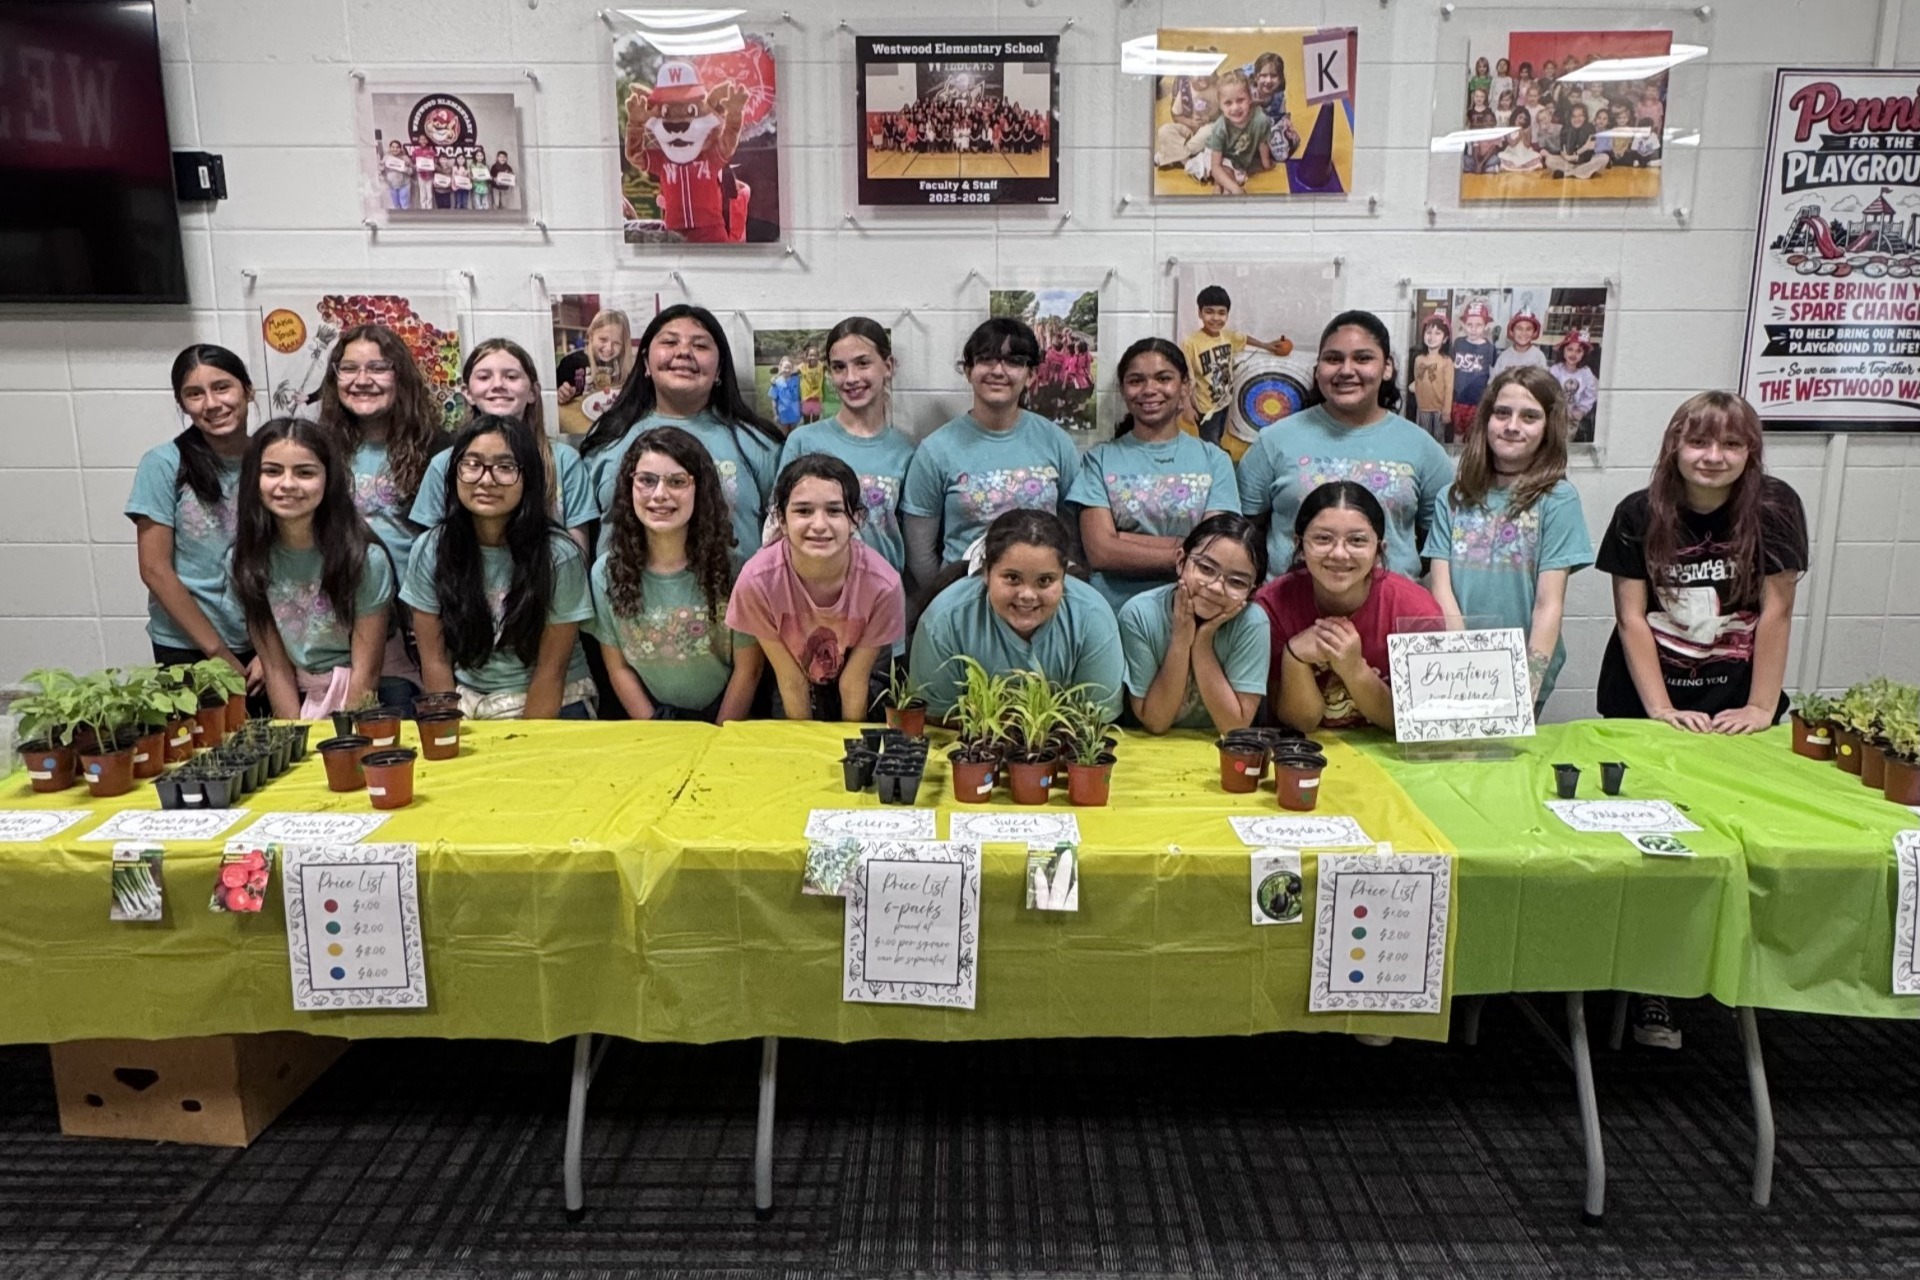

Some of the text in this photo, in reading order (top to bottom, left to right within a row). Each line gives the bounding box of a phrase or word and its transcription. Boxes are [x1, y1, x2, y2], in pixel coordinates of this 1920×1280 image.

[872, 42, 1044, 56] Westwood Elementary School
[667, 68, 683, 83] W
[1317, 50, 1338, 92] K
[1849, 136, 1915, 149] FOR THE
[1785, 152, 1920, 189] PLAYGROU
[918, 180, 998, 192] Faculty & Staff
[928, 193, 991, 203] 2025-2026
[1769, 281, 1830, 301] PLEASE
[1833, 282, 1886, 300] BRING
[1889, 283, 1908, 300] IN
[1789, 302, 1847, 321] SPARE
[1788, 328, 1804, 339] TO
[1806, 328, 1835, 339] HELP
[1837, 328, 1870, 339] BRING
[1872, 328, 1895, 339] OUR
[1788, 342, 1920, 353] PLAYGROUND TO LIFE!
[1787, 362, 1802, 376] So
[1804, 366, 1817, 374] we
[1840, 362, 1867, 375] work
[1759, 380, 1791, 402] THE
[1795, 377, 1894, 400] WESTWOOD
[1420, 661, 1499, 697] Donations
[1706, 675, 1728, 685] YOU
[317, 870, 388, 895] Price List
[882, 872, 952, 898] Price List
[1350, 879, 1420, 902] Price List
[884, 900, 943, 922] 6-packs
